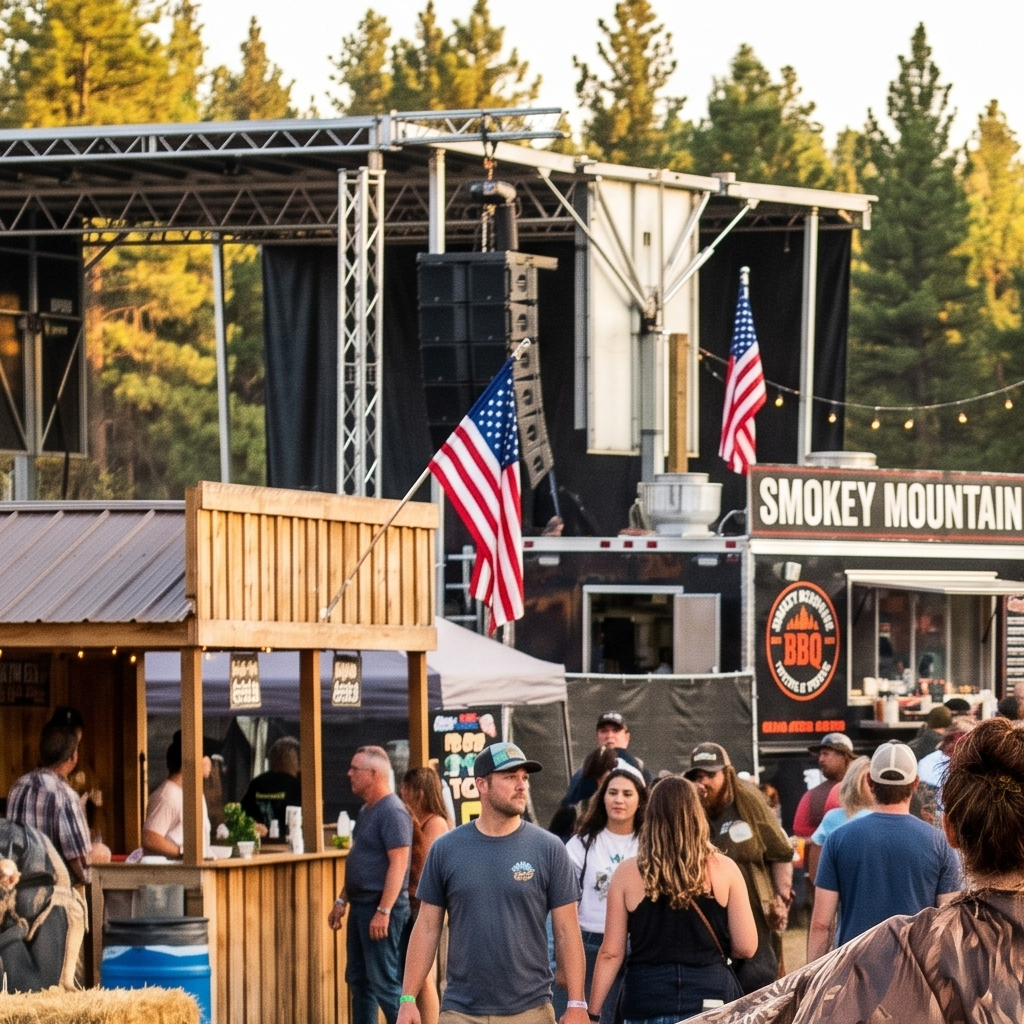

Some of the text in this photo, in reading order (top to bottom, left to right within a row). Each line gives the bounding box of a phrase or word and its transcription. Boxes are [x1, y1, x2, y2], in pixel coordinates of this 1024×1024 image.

[759, 477, 876, 527] SMOKEY
[884, 482, 1022, 531] MOUNTAIN
[784, 632, 822, 670] BBQ
